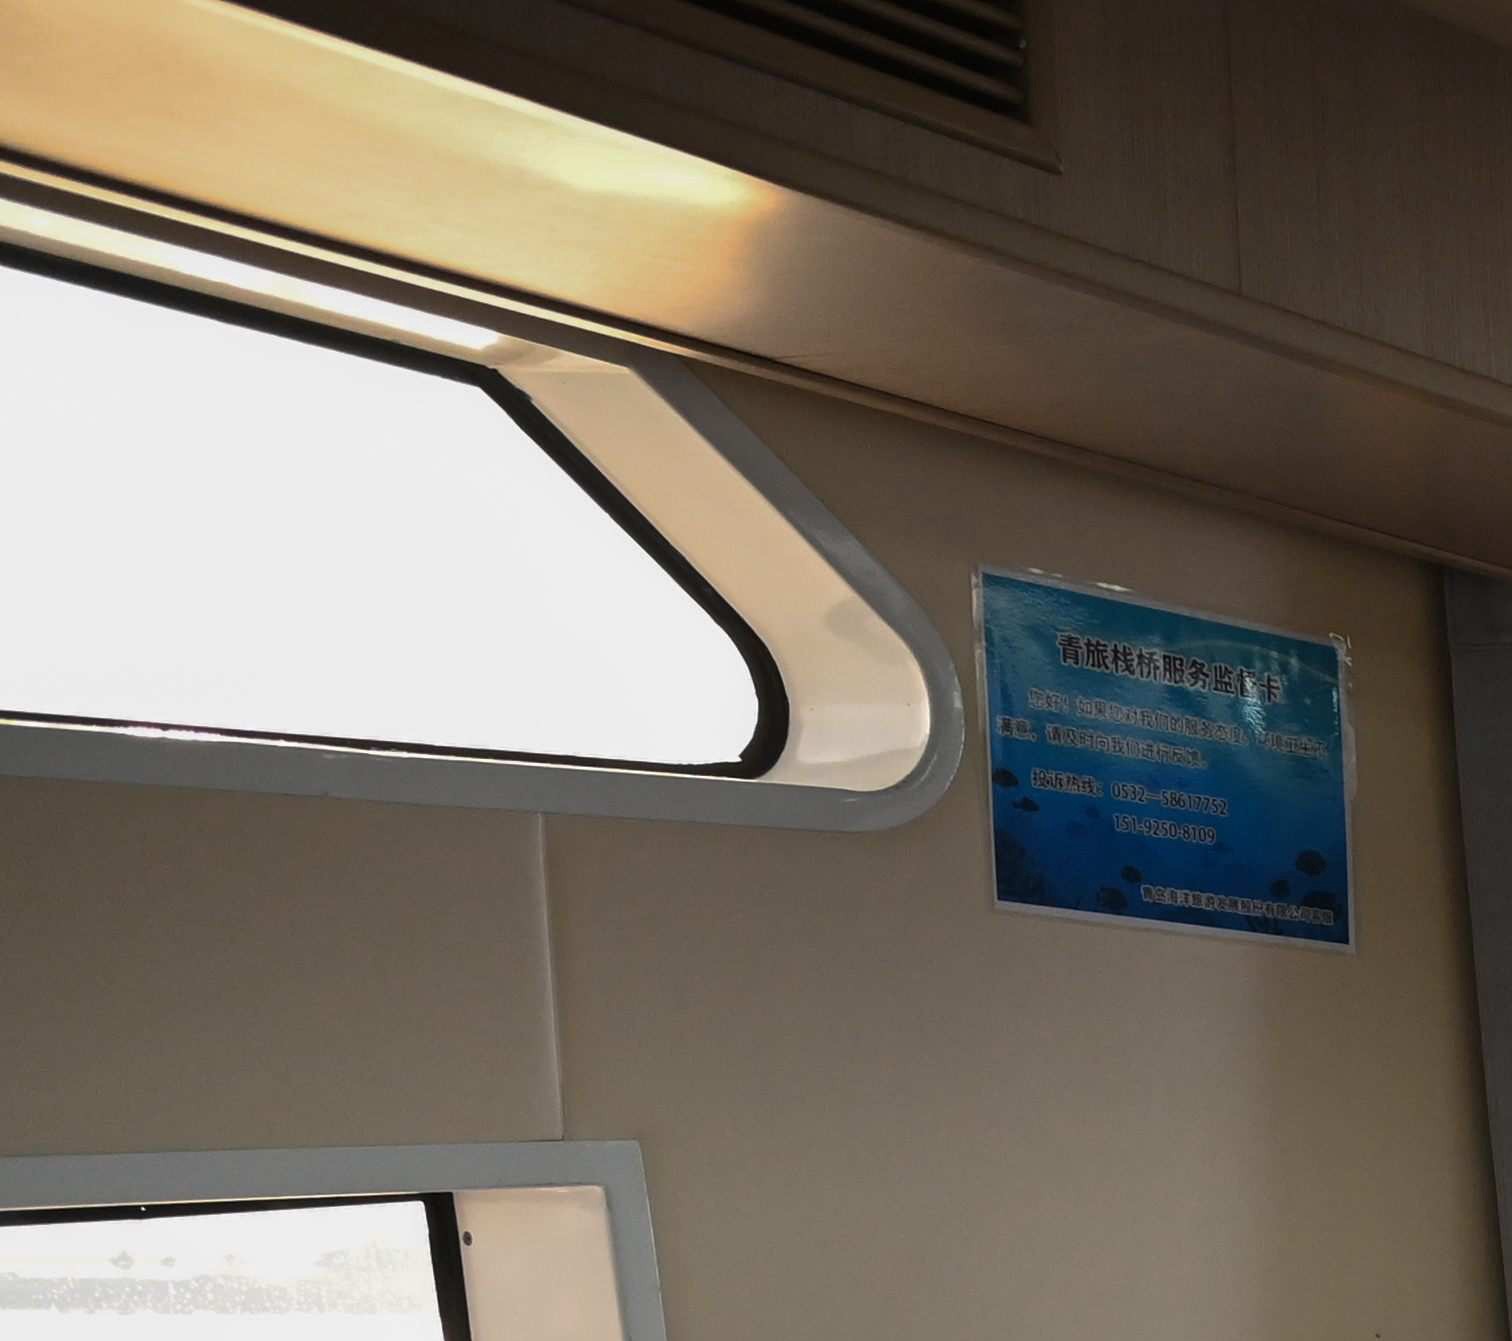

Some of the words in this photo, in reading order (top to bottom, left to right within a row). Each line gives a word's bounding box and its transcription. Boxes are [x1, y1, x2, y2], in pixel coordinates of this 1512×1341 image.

[1057, 632, 1282, 704] 青旅栈桥服务监督卡
[1113, 813, 1217, 845] 151-9250-8109
